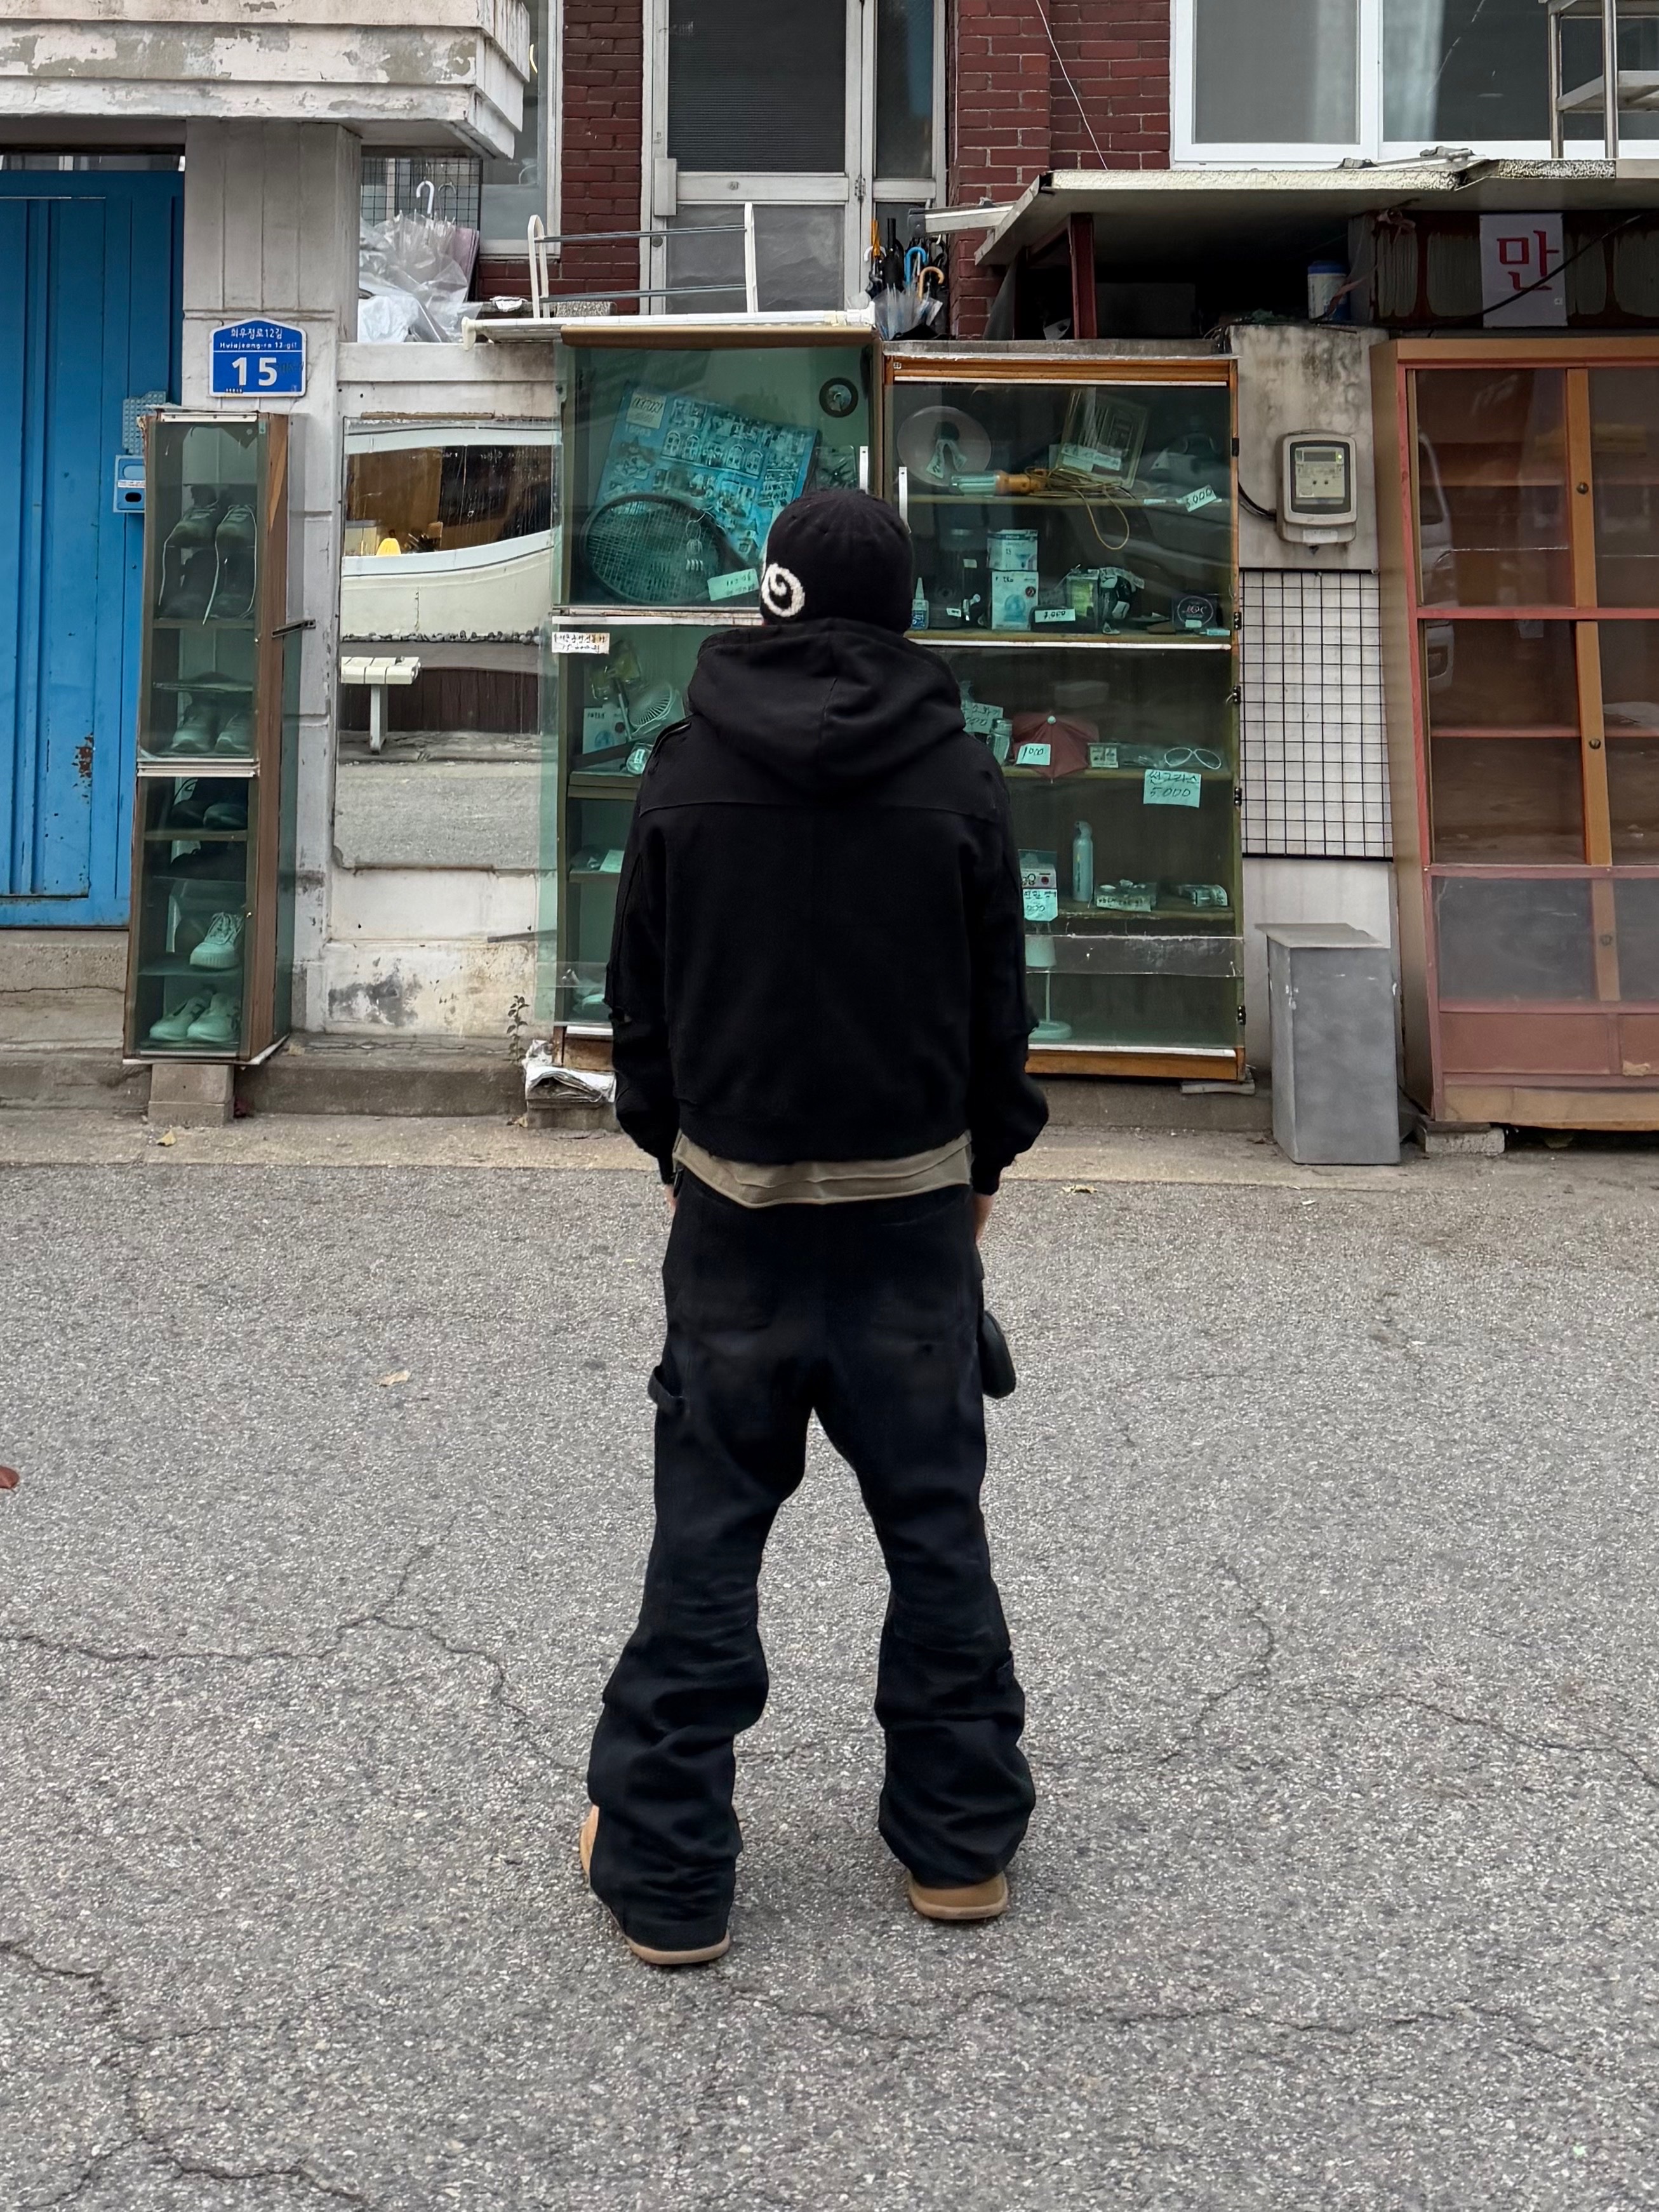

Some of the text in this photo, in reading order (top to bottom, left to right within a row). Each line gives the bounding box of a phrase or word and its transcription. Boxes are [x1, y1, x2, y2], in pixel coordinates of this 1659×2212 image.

[1496, 229, 1560, 291] 만
[230, 328, 283, 340] 희우정로12길
[232, 356, 277, 386] 15
